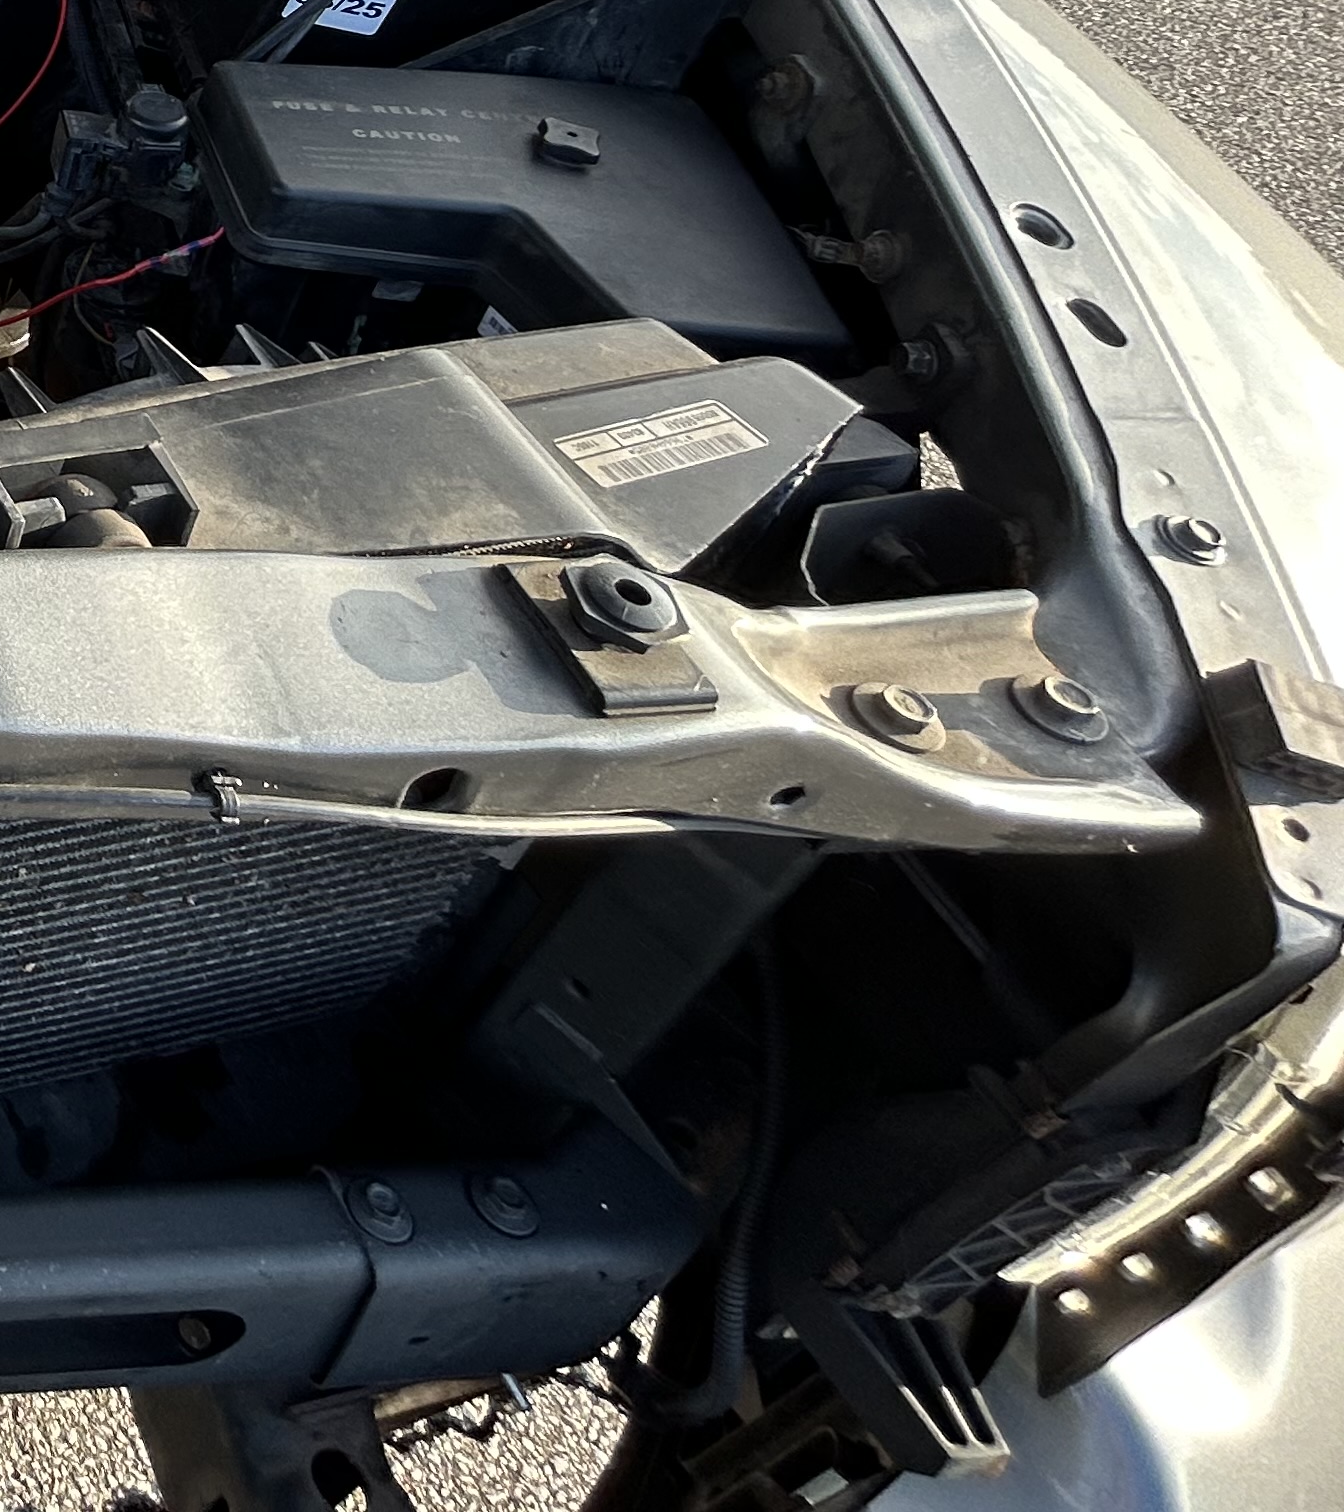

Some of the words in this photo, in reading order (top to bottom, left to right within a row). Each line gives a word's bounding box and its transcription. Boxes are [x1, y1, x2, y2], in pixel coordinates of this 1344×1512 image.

[272, 100, 335, 113] FUSE
[372, 103, 448, 118] RELAY
[351, 128, 461, 144] CAUTION
